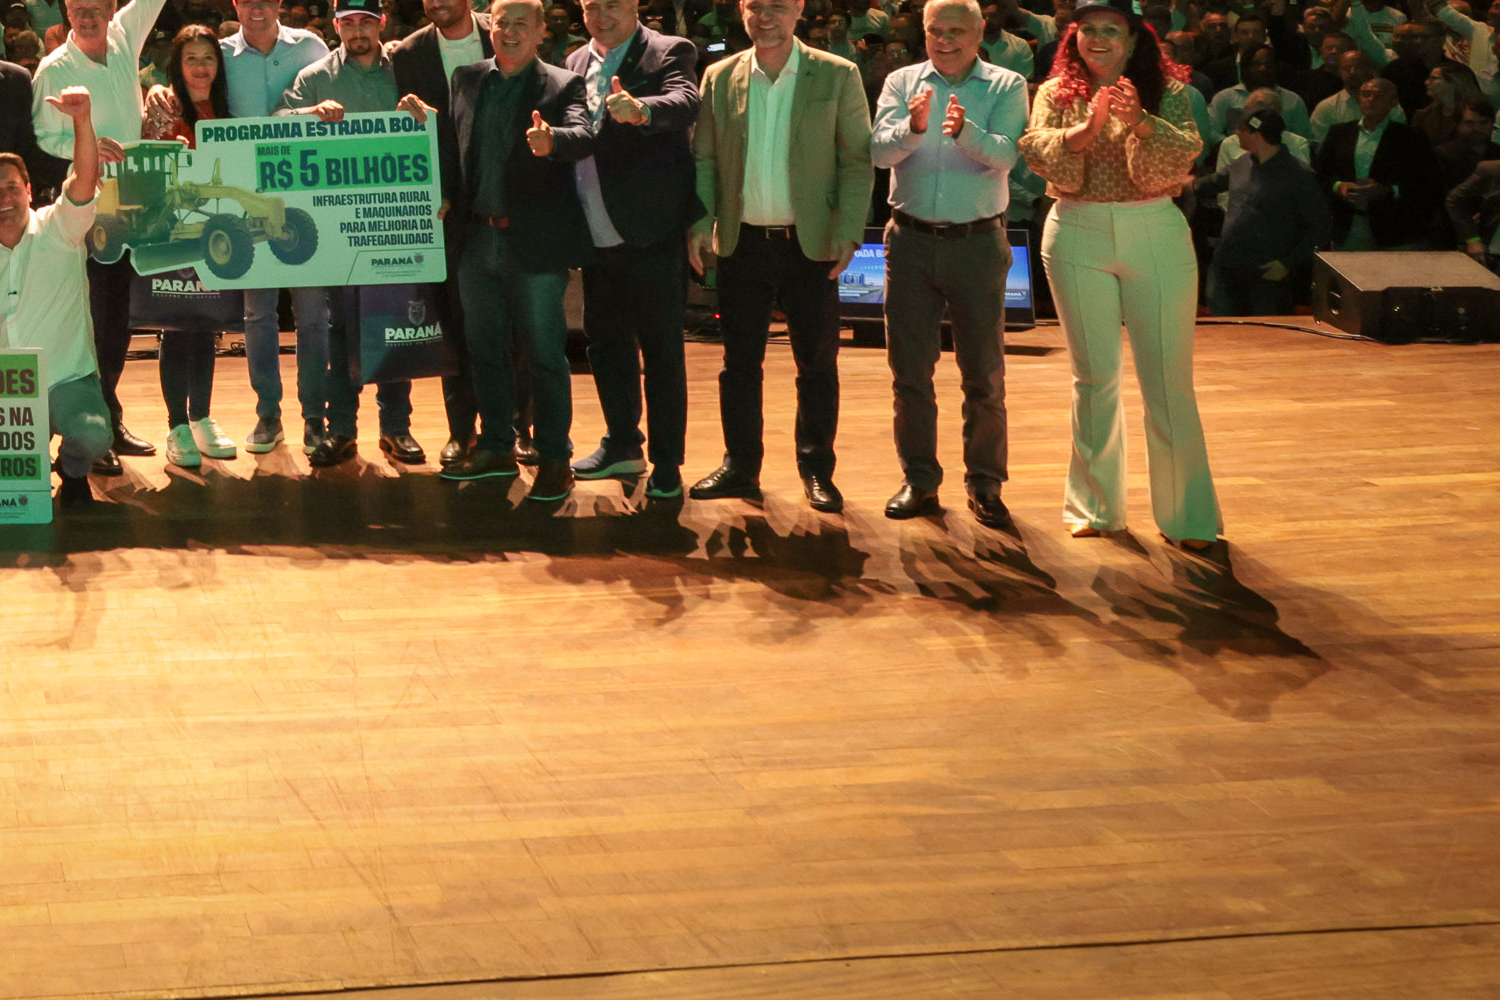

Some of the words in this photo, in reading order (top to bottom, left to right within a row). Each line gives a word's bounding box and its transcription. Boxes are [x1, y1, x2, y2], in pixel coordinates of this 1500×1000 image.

[202, 121, 302, 143] PROGRAMA
[306, 119, 386, 138] ESTRADA
[389, 116, 426, 133] BOA
[258, 146, 279, 156] MAIS
[281, 145, 291, 155] DE
[260, 159, 293, 190] R$
[300, 149, 320, 187] 5
[326, 152, 429, 186] BILHÕES
[313, 193, 397, 207] INFRAESTRUTURA
[399, 190, 432, 204] RURAL
[355, 207, 361, 219] E
[340, 221, 366, 234] PARA
[367, 219, 418, 233] MELHORIA
[419, 218, 433, 231] DA
[347, 232, 434, 247] TRAFEGABILIDADE
[371, 256, 414, 267] PARANÁ
[152, 278, 220, 292] PARAN
[385, 322, 443, 340] PARANÁ
[9, 407, 34, 427] NA
[0, 431, 35, 450] DOS
